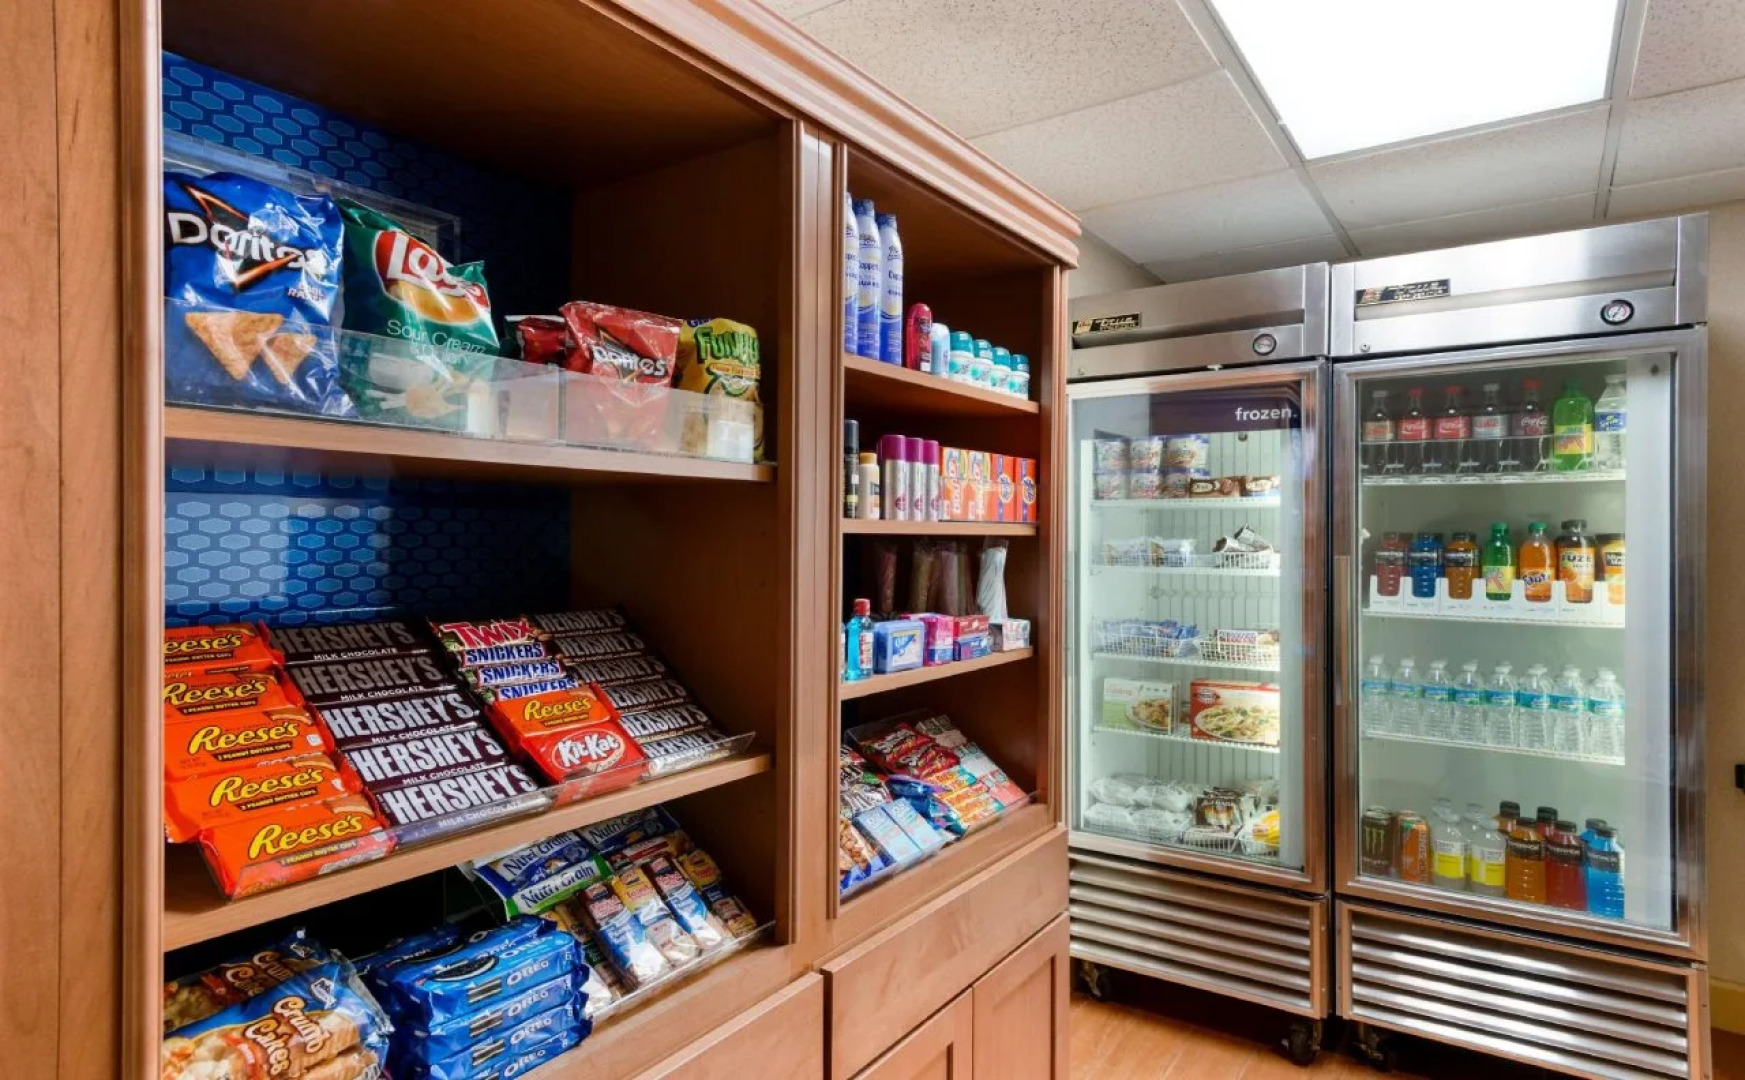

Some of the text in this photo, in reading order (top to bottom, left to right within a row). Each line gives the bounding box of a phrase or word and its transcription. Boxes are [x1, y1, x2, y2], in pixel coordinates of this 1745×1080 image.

[168, 212, 328, 276] Doritos
[387, 319, 487, 353] Sour Cream
[592, 344, 668, 377] Doritos
[165, 634, 241, 654] eese's
[269, 622, 415, 654] HERSHEY'S
[313, 648, 397, 661] MILK CHOCOLATE
[465, 642, 543, 663] SNICKERS
[292, 656, 444, 696] HERSHEY'S
[481, 659, 560, 684] SNICKERS
[164, 680, 267, 706] Reese's
[340, 685, 425, 701] MILK CHOCOLATE
[500, 676, 579, 698] SNICKERS
[321, 693, 473, 739] HERSHEY'S
[525, 697, 592, 721] Reese's
[619, 704, 709, 738] HERSHEY'S
[188, 722, 299, 754] Reese's
[372, 724, 455, 744] MILK CHOCOLATE
[350, 728, 504, 782] HERSHEY'S
[210, 768, 324, 807] Reese's
[402, 762, 486, 786] MILK CHOCOLATE
[382, 764, 539, 825] HERSHEY'S
[438, 816, 464, 828] MILK
[249, 815, 364, 859] Reese's
[507, 959, 549, 986] OREO
[508, 990, 549, 1017] OREO
[274, 996, 324, 1053] Crumb
[510, 1017, 552, 1044] OREO
[245, 1019, 290, 1076] Cakes
[504, 1049, 547, 1077] OREO
